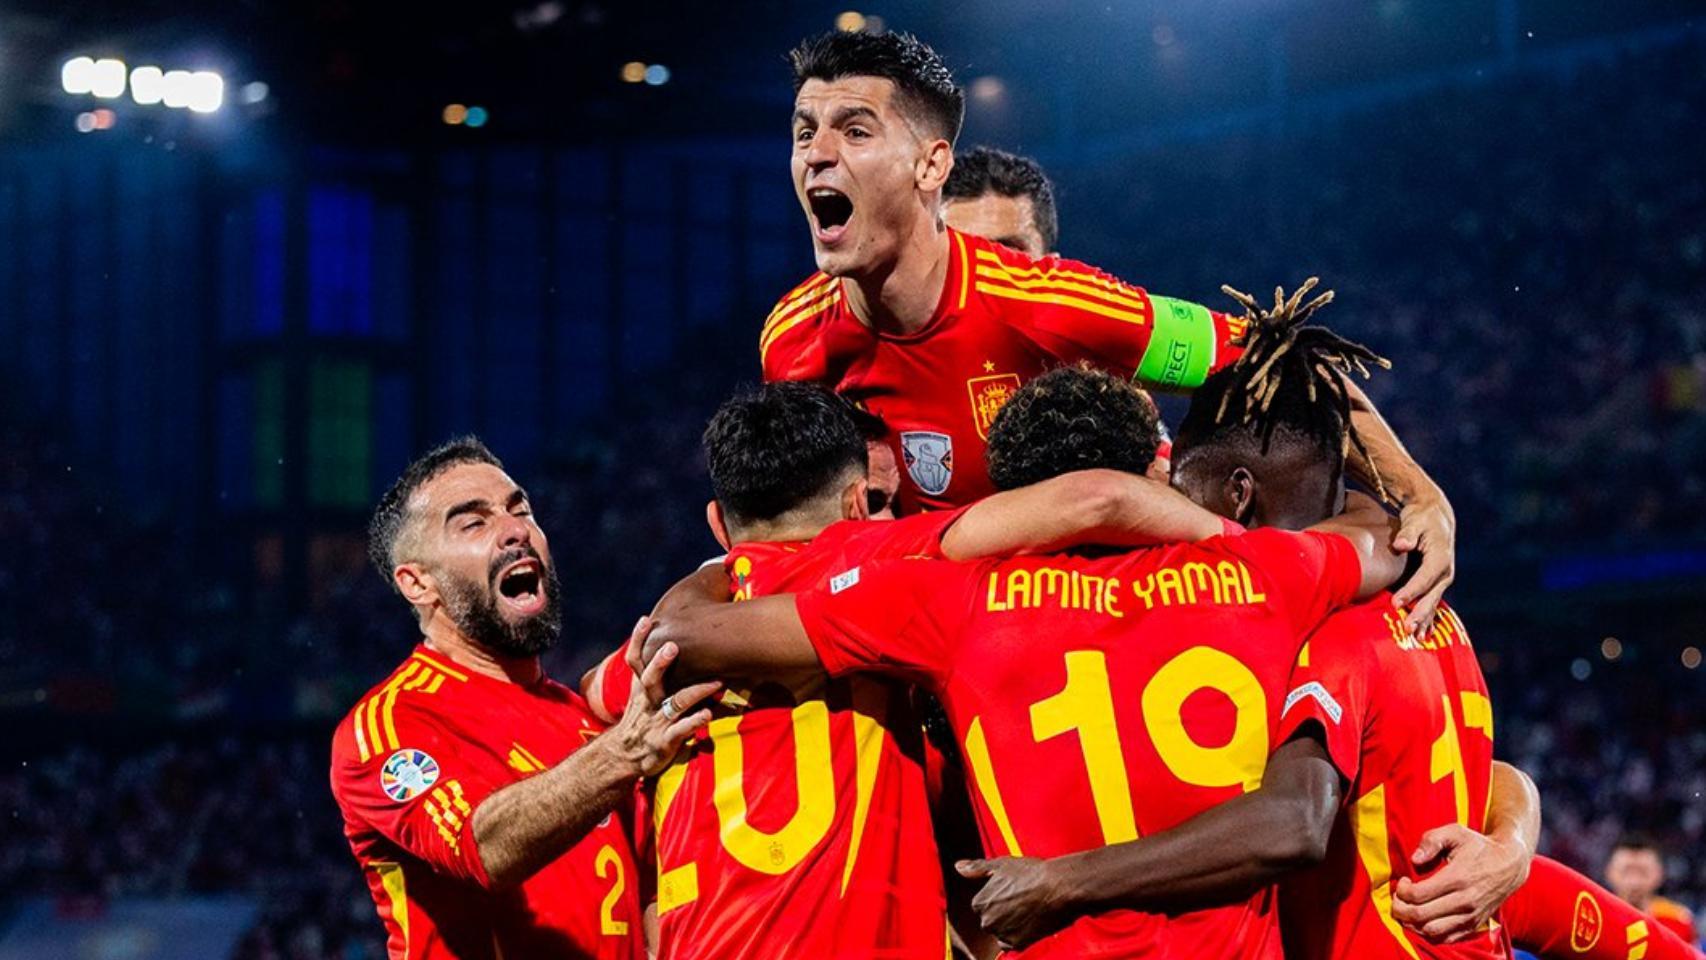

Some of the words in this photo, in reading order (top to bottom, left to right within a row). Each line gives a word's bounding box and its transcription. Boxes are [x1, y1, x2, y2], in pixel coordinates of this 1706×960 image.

[987, 567, 1124, 618] LAMINE
[1133, 560, 1266, 610] YAMAL
[1029, 645, 1270, 846] 19
[594, 843, 629, 936] 2
